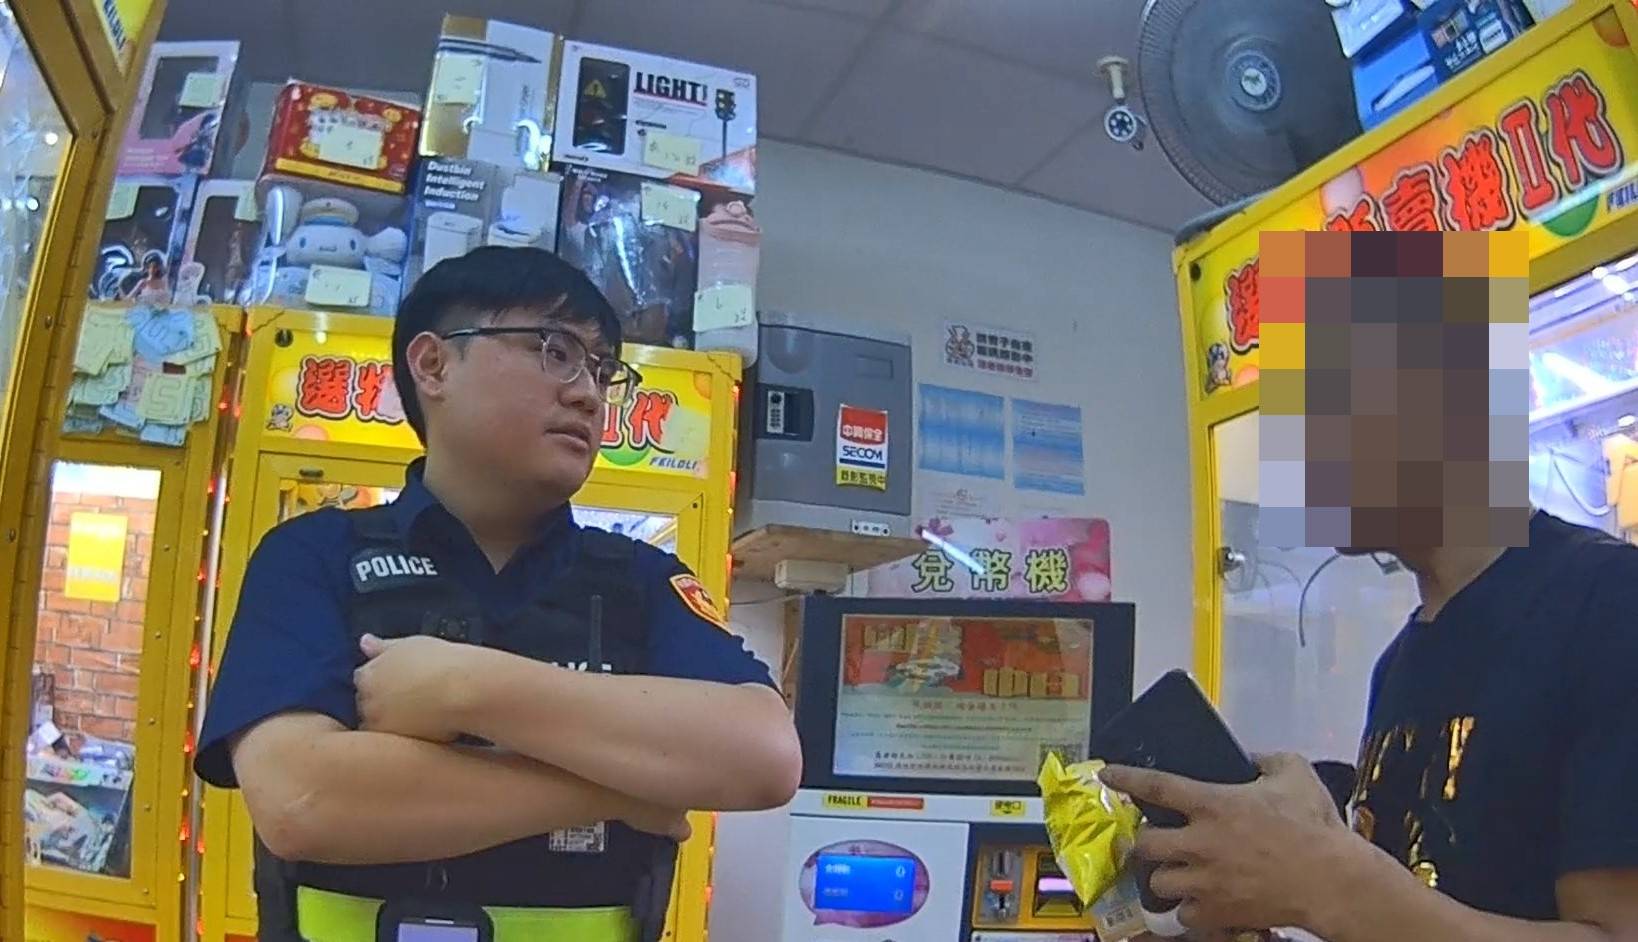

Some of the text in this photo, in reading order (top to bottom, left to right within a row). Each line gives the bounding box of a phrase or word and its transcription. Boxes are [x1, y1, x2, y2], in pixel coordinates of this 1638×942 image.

[634, 71, 708, 105] LIGHT!
[428, 160, 472, 176] Dustbin
[425, 173, 485, 190] Intelligent
[424, 185, 479, 201] Induction
[842, 446, 882, 461] SECOM
[355, 554, 438, 582] POLICE
[827, 794, 861, 806] FRAGILE
